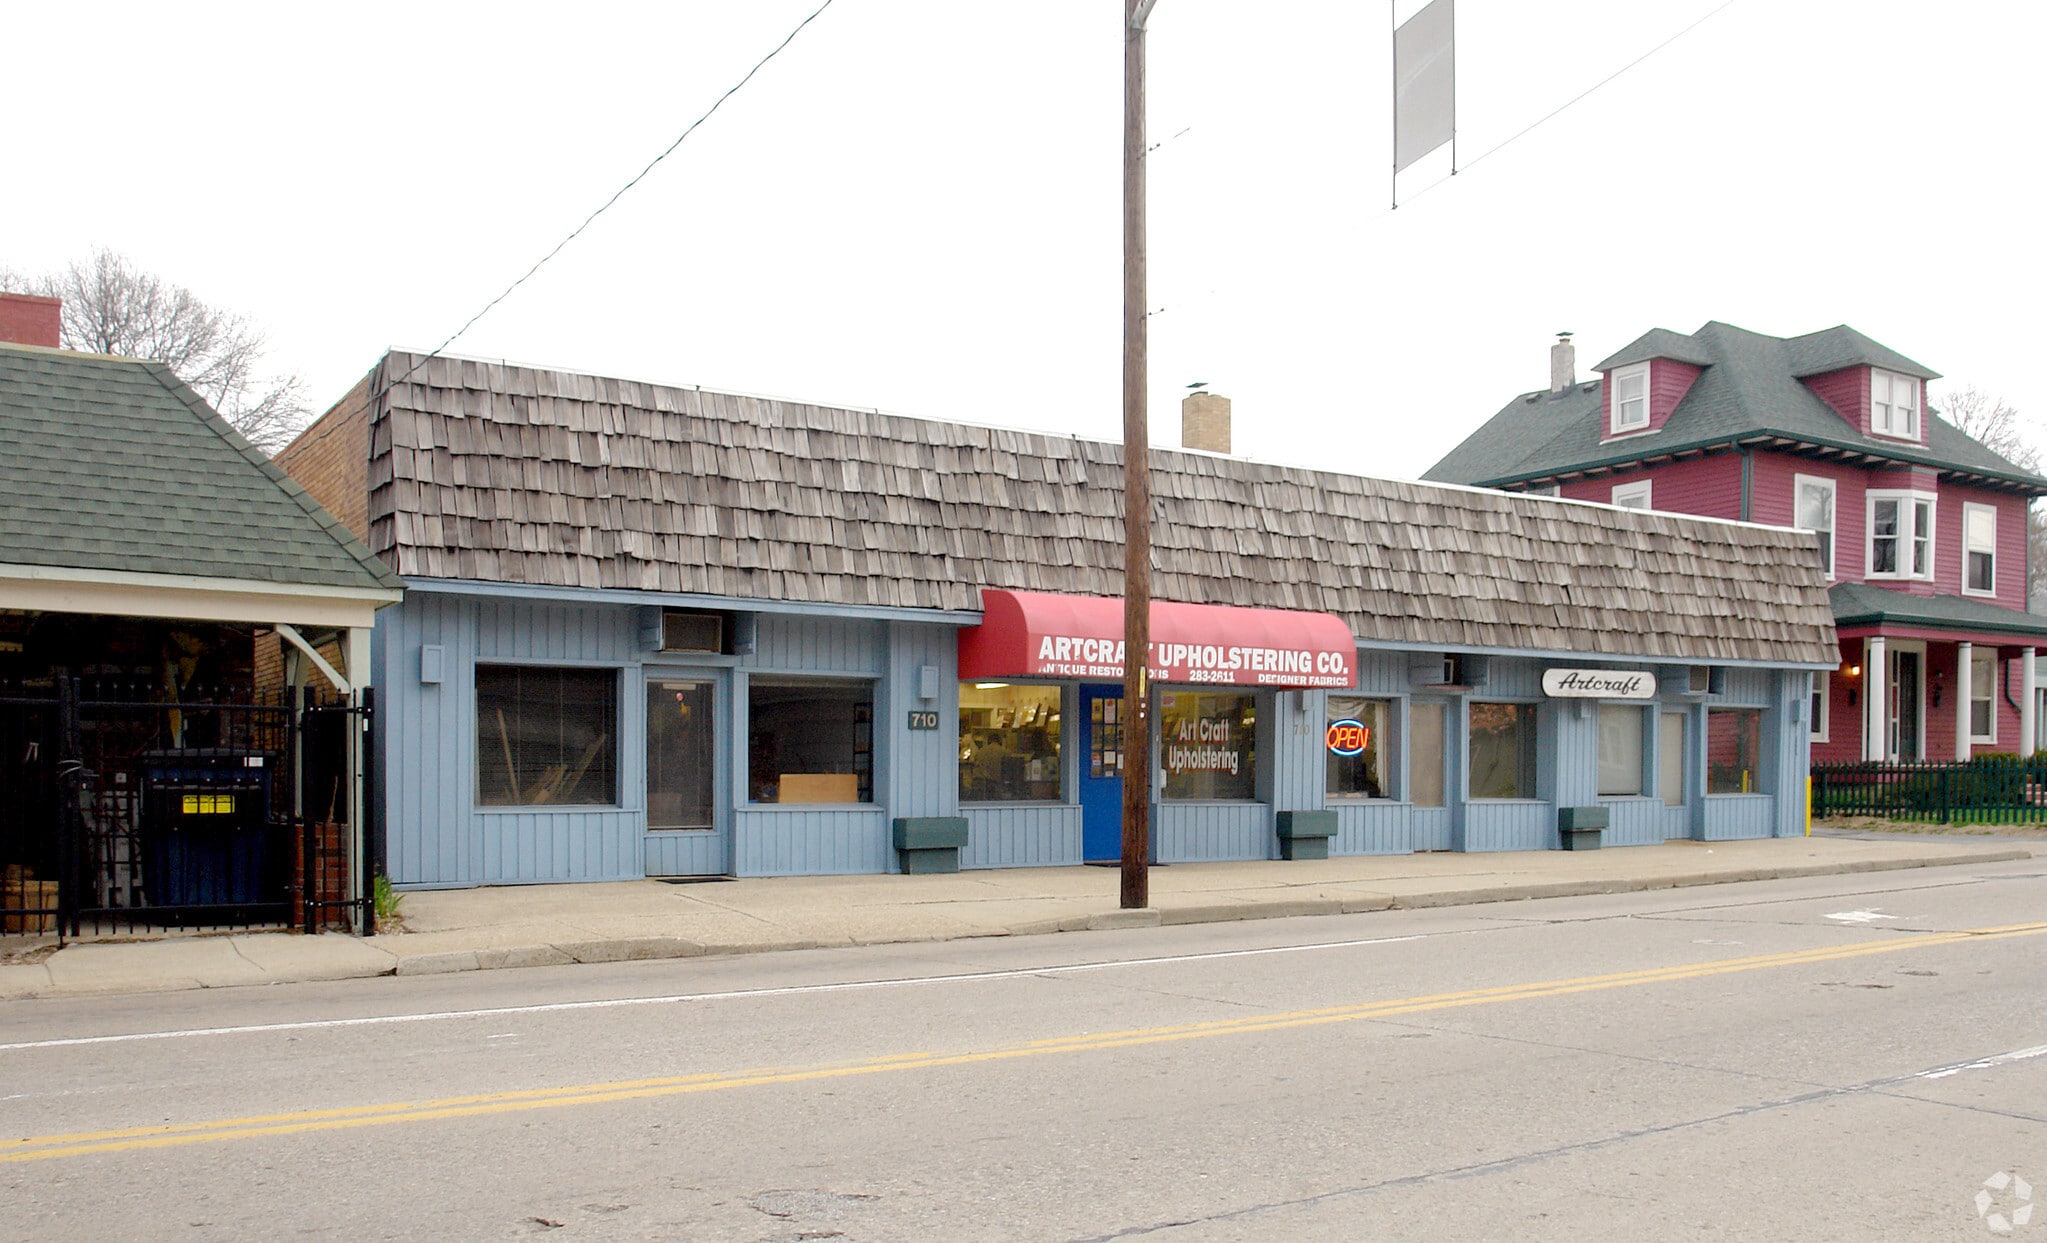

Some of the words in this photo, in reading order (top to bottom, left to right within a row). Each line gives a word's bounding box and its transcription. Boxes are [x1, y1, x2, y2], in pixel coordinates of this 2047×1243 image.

[1039, 636, 1153, 664] ARTCRA
[1159, 643, 1312, 674] UPHOLSTERING
[1317, 651, 1349, 674] CO.
[1189, 669, 1235, 682] 283-2611
[1558, 672, 1641, 695] Artcraft
[912, 713, 937, 727] 710
[1179, 718, 1196, 741] Art
[1200, 718, 1229, 742] Craft
[1326, 727, 1369, 749] OPEN
[1169, 746, 1239, 775] Upholstering
